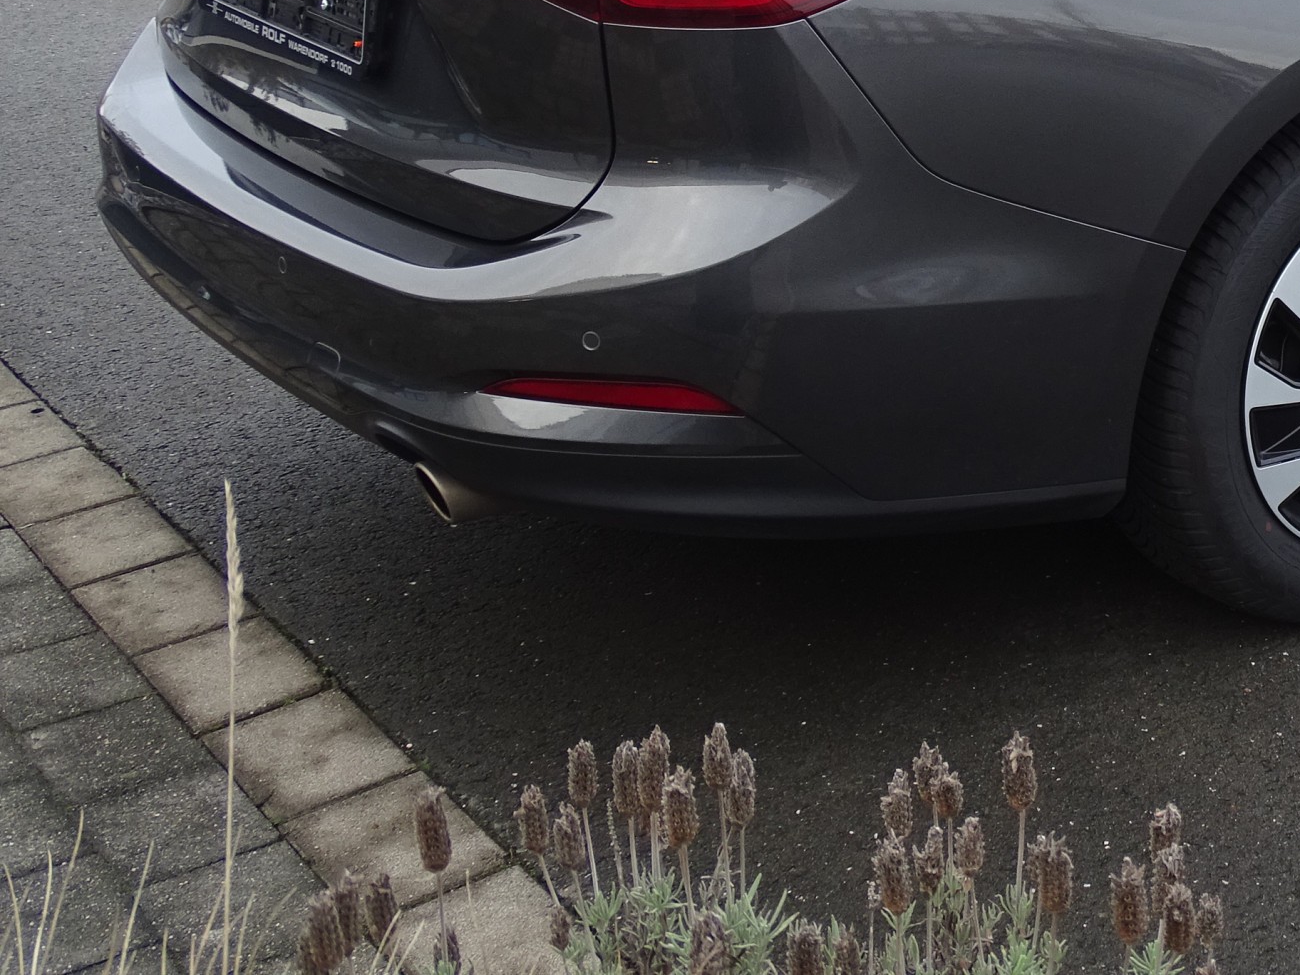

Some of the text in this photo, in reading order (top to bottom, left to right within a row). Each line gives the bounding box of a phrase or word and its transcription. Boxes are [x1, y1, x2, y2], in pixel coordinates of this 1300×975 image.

[224, 11, 260, 35] AUTOMOBILE
[261, 25, 286, 45] ROLF
[288, 39, 329, 64] WARENDORF
